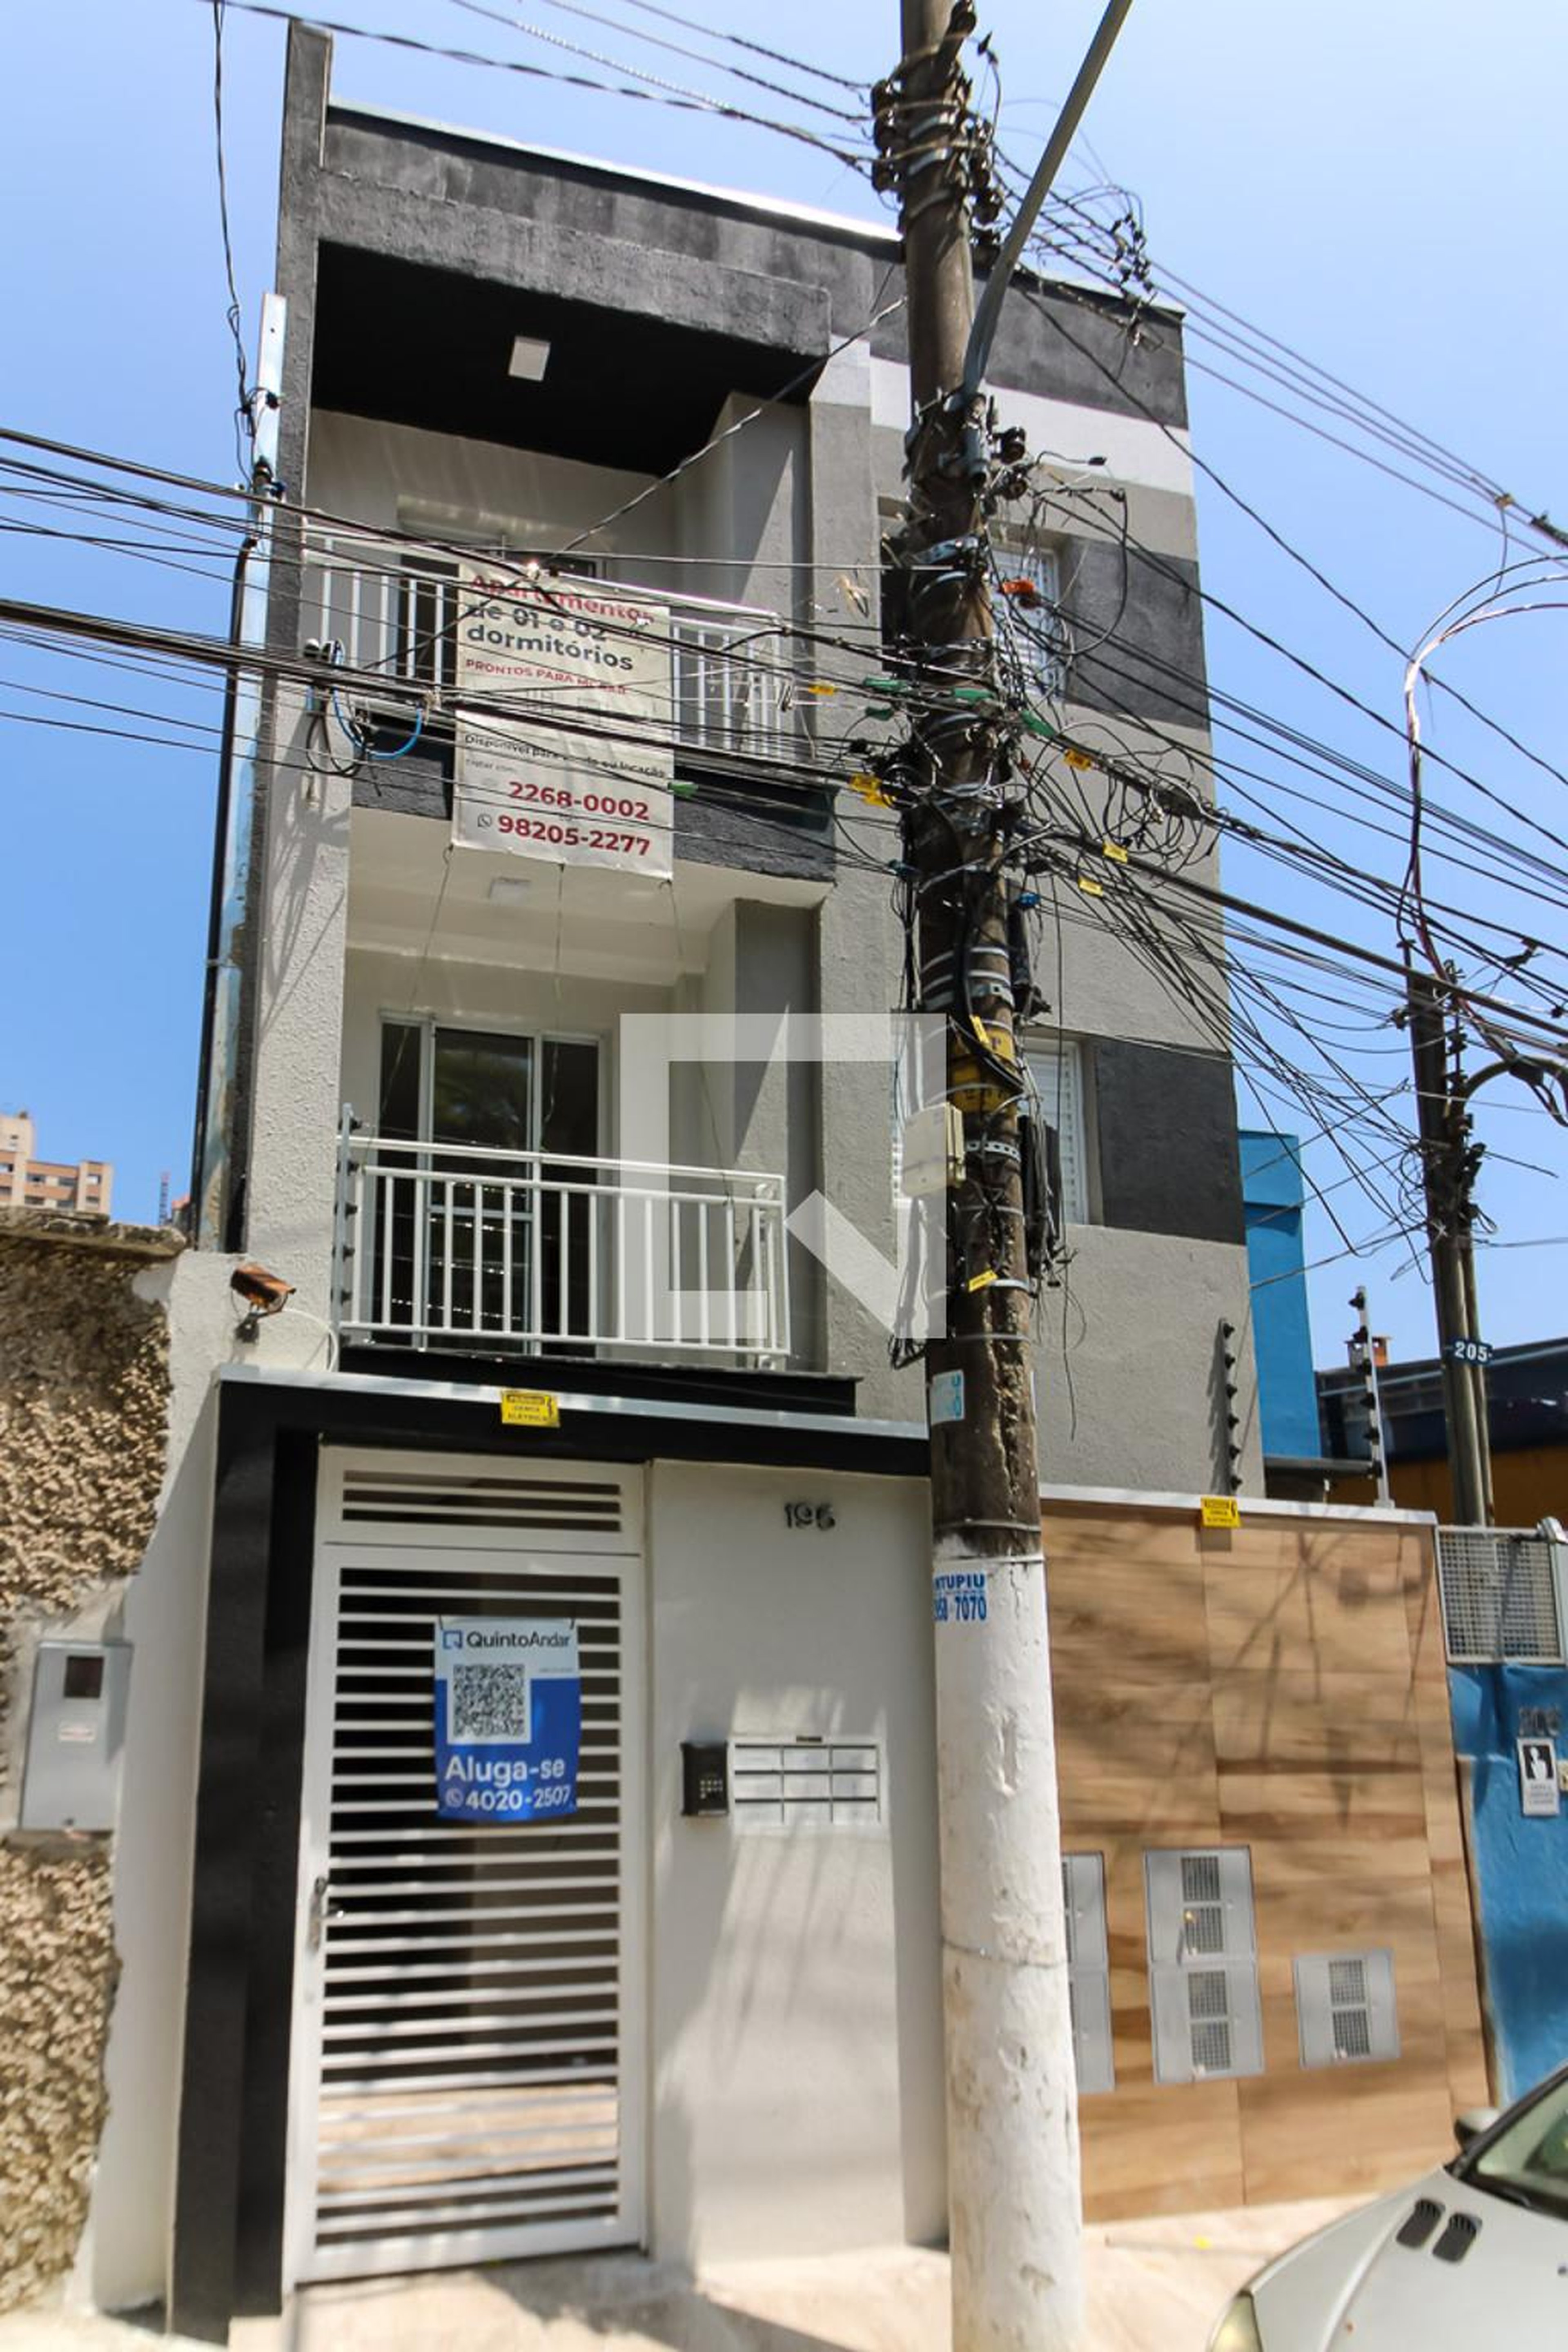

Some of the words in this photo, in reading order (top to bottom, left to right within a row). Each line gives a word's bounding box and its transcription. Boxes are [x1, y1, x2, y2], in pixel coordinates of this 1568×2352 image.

[513, 608, 539, 629] 01
[550, 618, 564, 631] e
[468, 625, 633, 671] dormitórios
[466, 658, 532, 678] PRONTOS
[536, 669, 573, 684] PARA
[508, 781, 650, 821] 2268-0002
[498, 815, 650, 855] 98205-2277
[1454, 1340, 1488, 1362] 205
[784, 1503, 836, 1532] 196
[466, 1631, 570, 1649] QuintoAndar
[445, 1755, 565, 1788] Aluga-se
